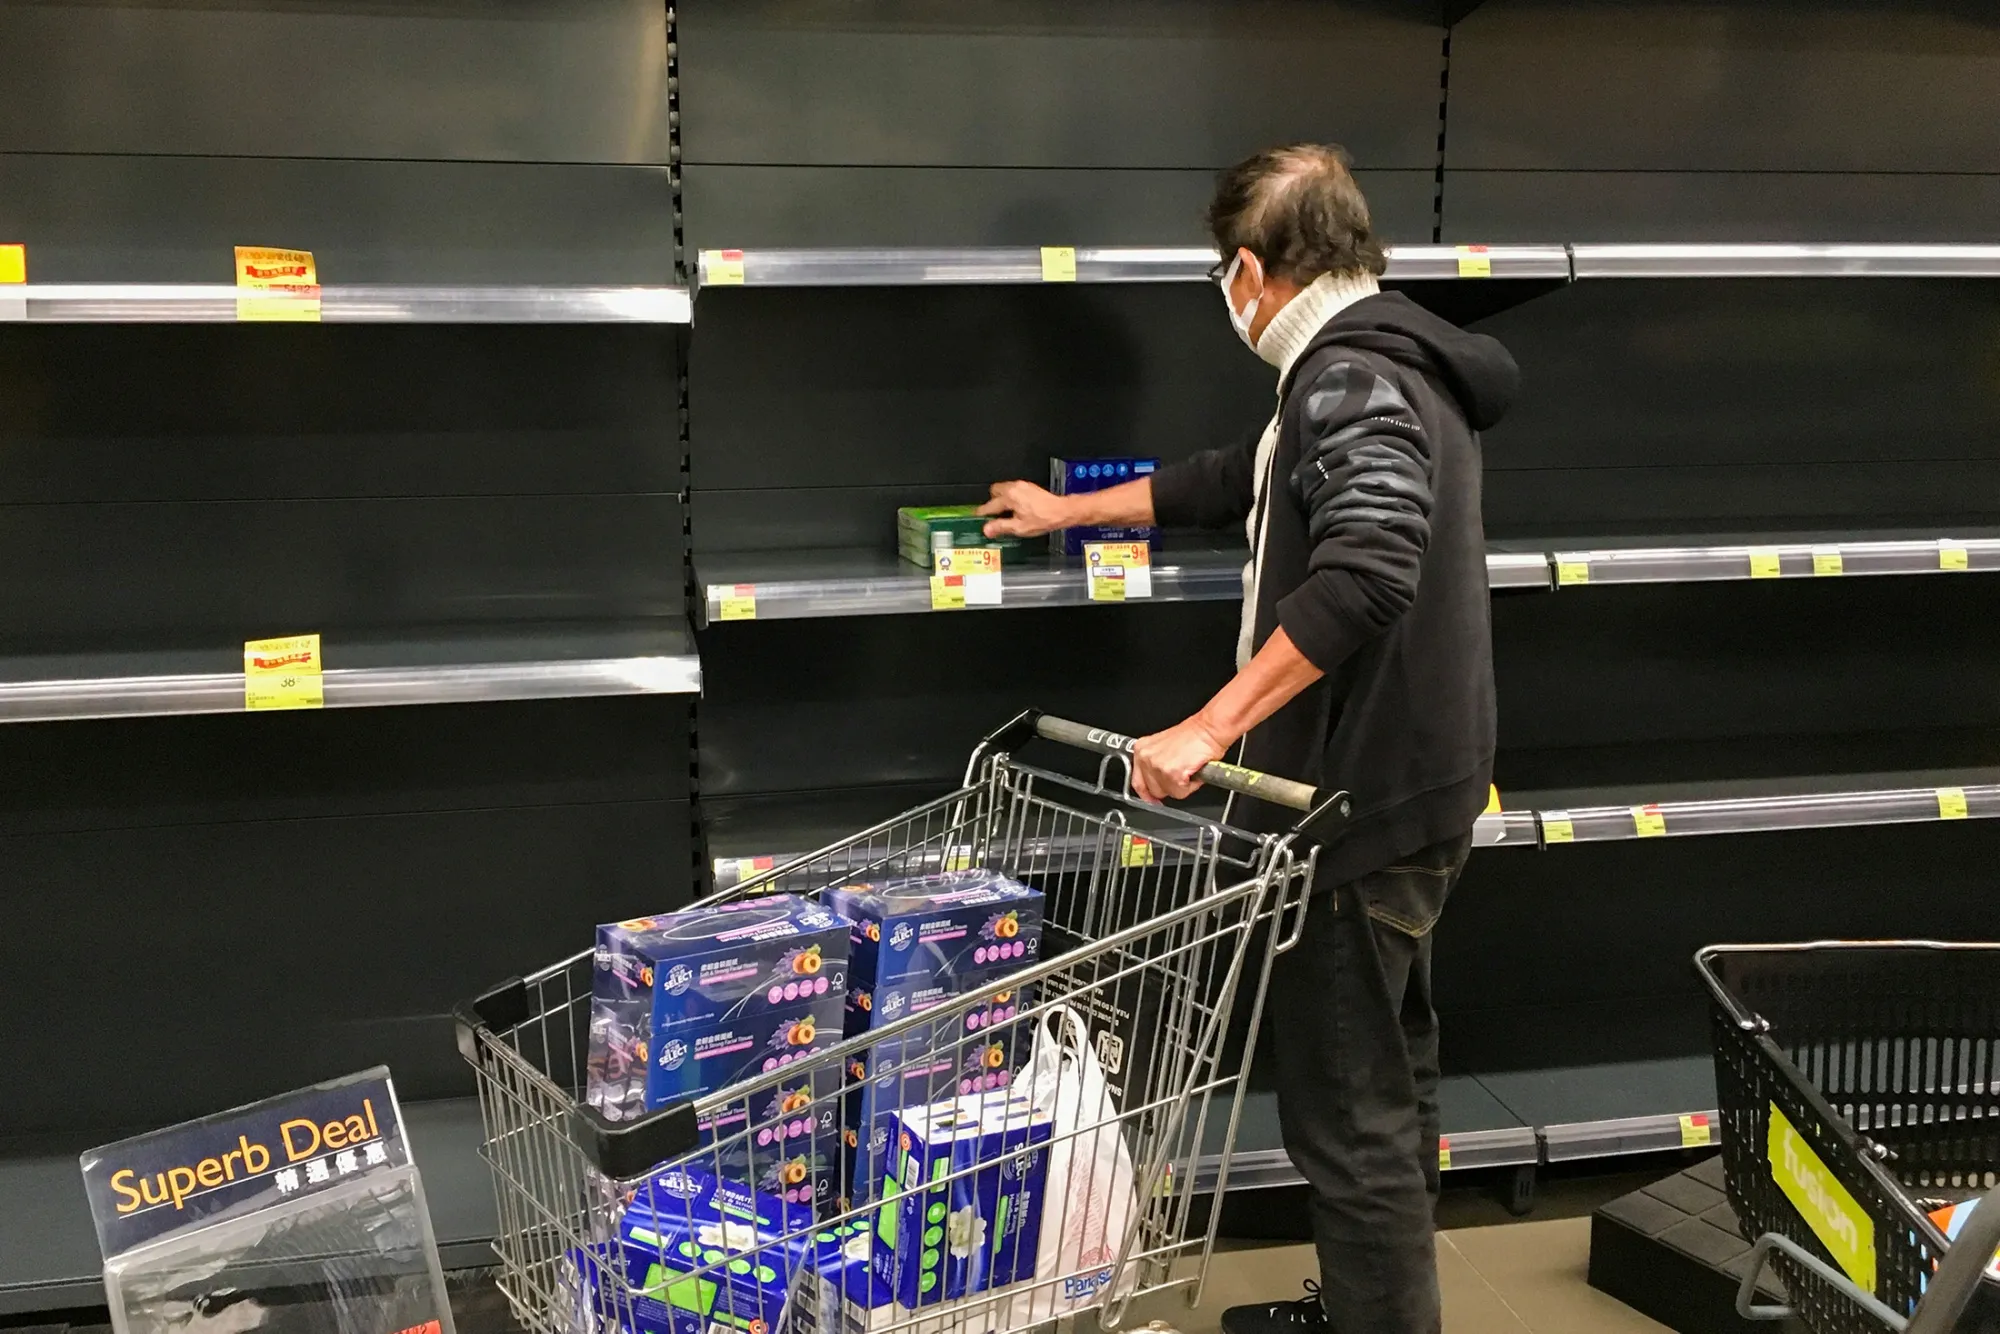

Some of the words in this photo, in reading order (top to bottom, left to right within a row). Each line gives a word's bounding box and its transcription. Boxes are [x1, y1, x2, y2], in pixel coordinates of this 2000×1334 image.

[890, 928, 913, 946] SELECT
[664, 970, 693, 991] SELECT
[881, 996, 906, 1015] SELECT
[659, 1045, 688, 1066] SELECT
[110, 1135, 270, 1212] Superb
[279, 1098, 379, 1162] Deal
